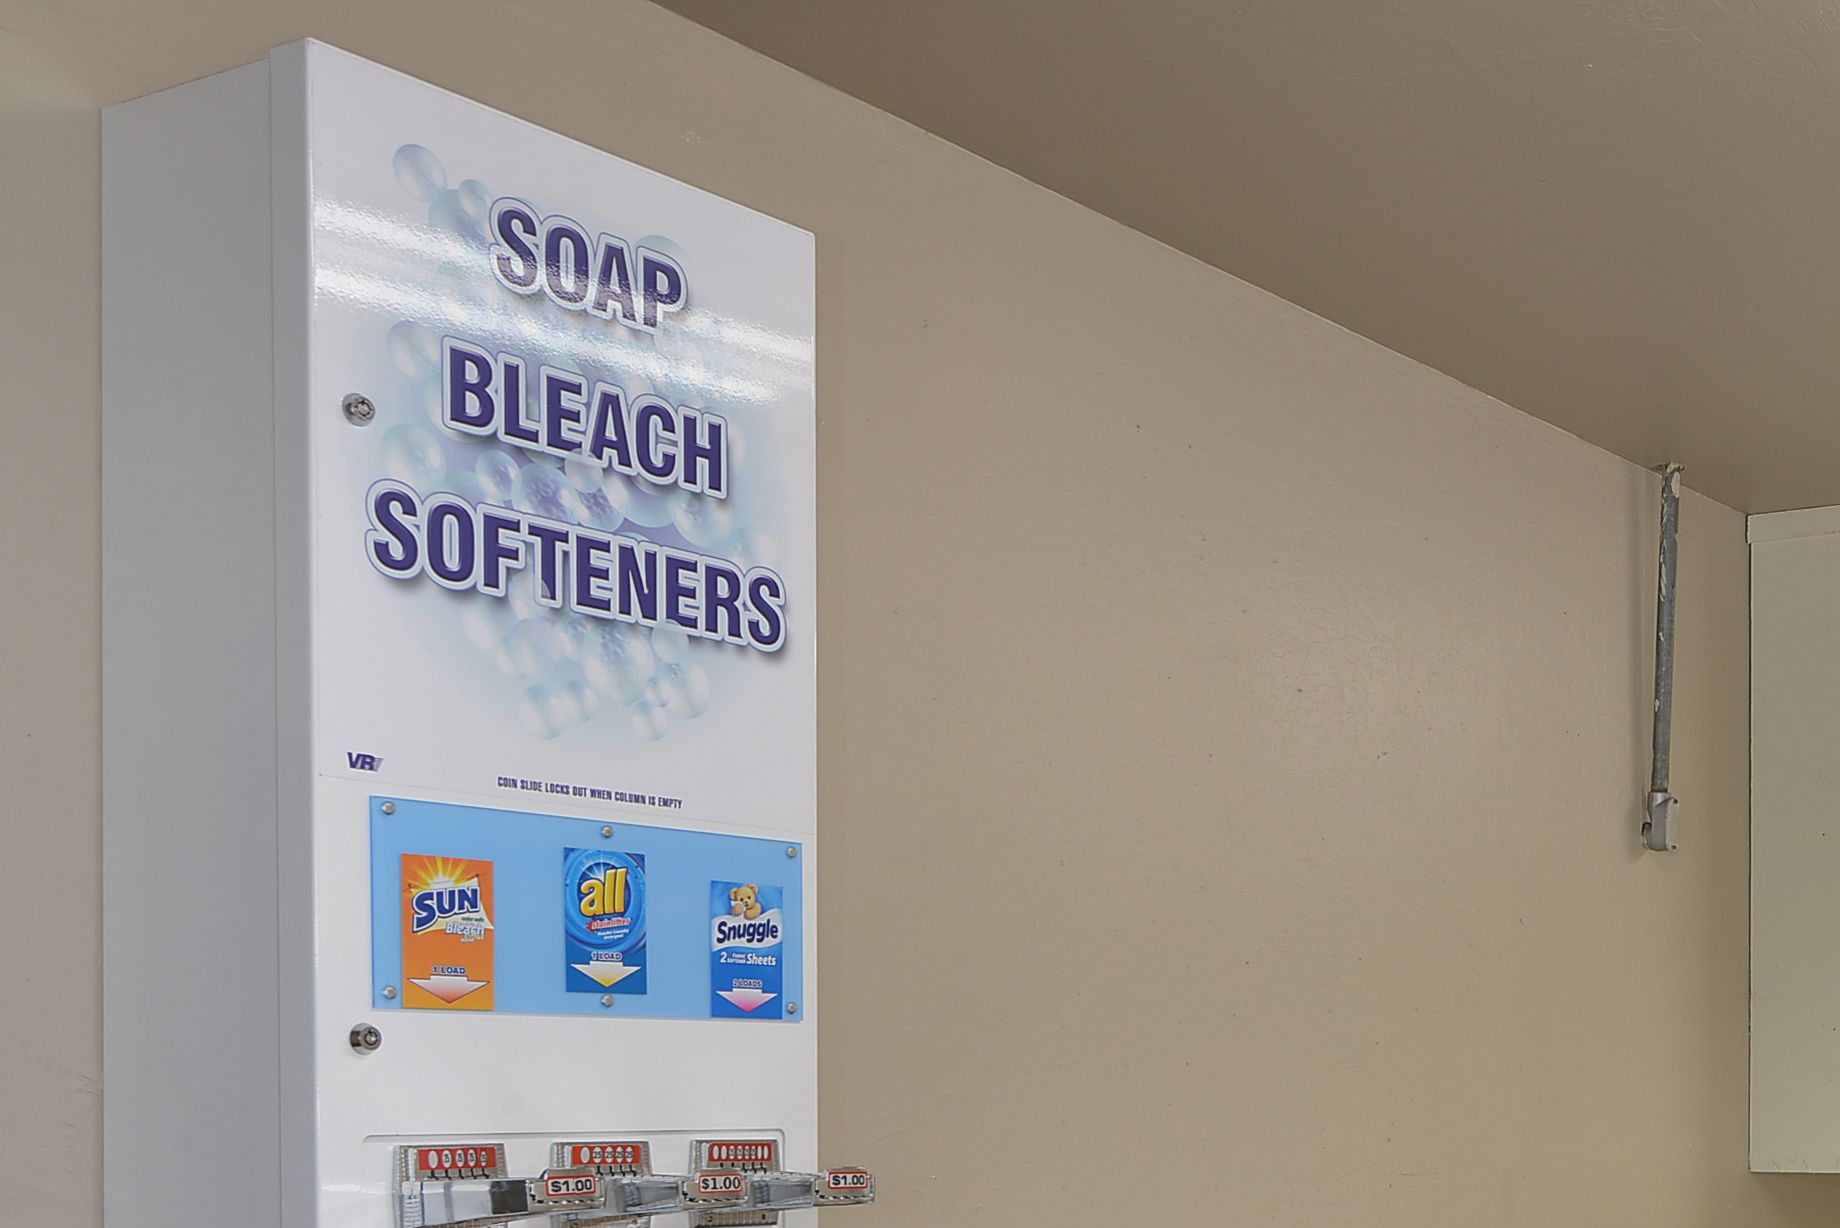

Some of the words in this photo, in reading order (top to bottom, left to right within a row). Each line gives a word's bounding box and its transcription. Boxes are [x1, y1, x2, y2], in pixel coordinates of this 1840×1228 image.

[493, 205, 686, 329] SOAP
[447, 344, 724, 494] BLEACH
[372, 488, 783, 646] SOFTENERS
[497, 776, 518, 789] COIN
[520, 779, 543, 792] SLIDE
[545, 782, 570, 795] LOCKS
[573, 786, 588, 797] OUT
[590, 788, 612, 801] WHEN
[614, 791, 647, 805] COLUMN
[648, 796, 656, 806] IS
[658, 797, 683, 809] EMPTY
[580, 867, 628, 916] all
[413, 887, 480, 932] SUN
[446, 922, 485, 940] Bleach
[716, 918, 779, 944] Snuggle
[600, 952, 622, 960] LOAD
[720, 951, 728, 963] 2
[746, 953, 777, 966] Sheets
[441, 966, 466, 974] LOAD
[550, 1178, 593, 1193] $1.00
[702, 1176, 741, 1190] $1.00
[832, 1174, 865, 1186] $1.00
